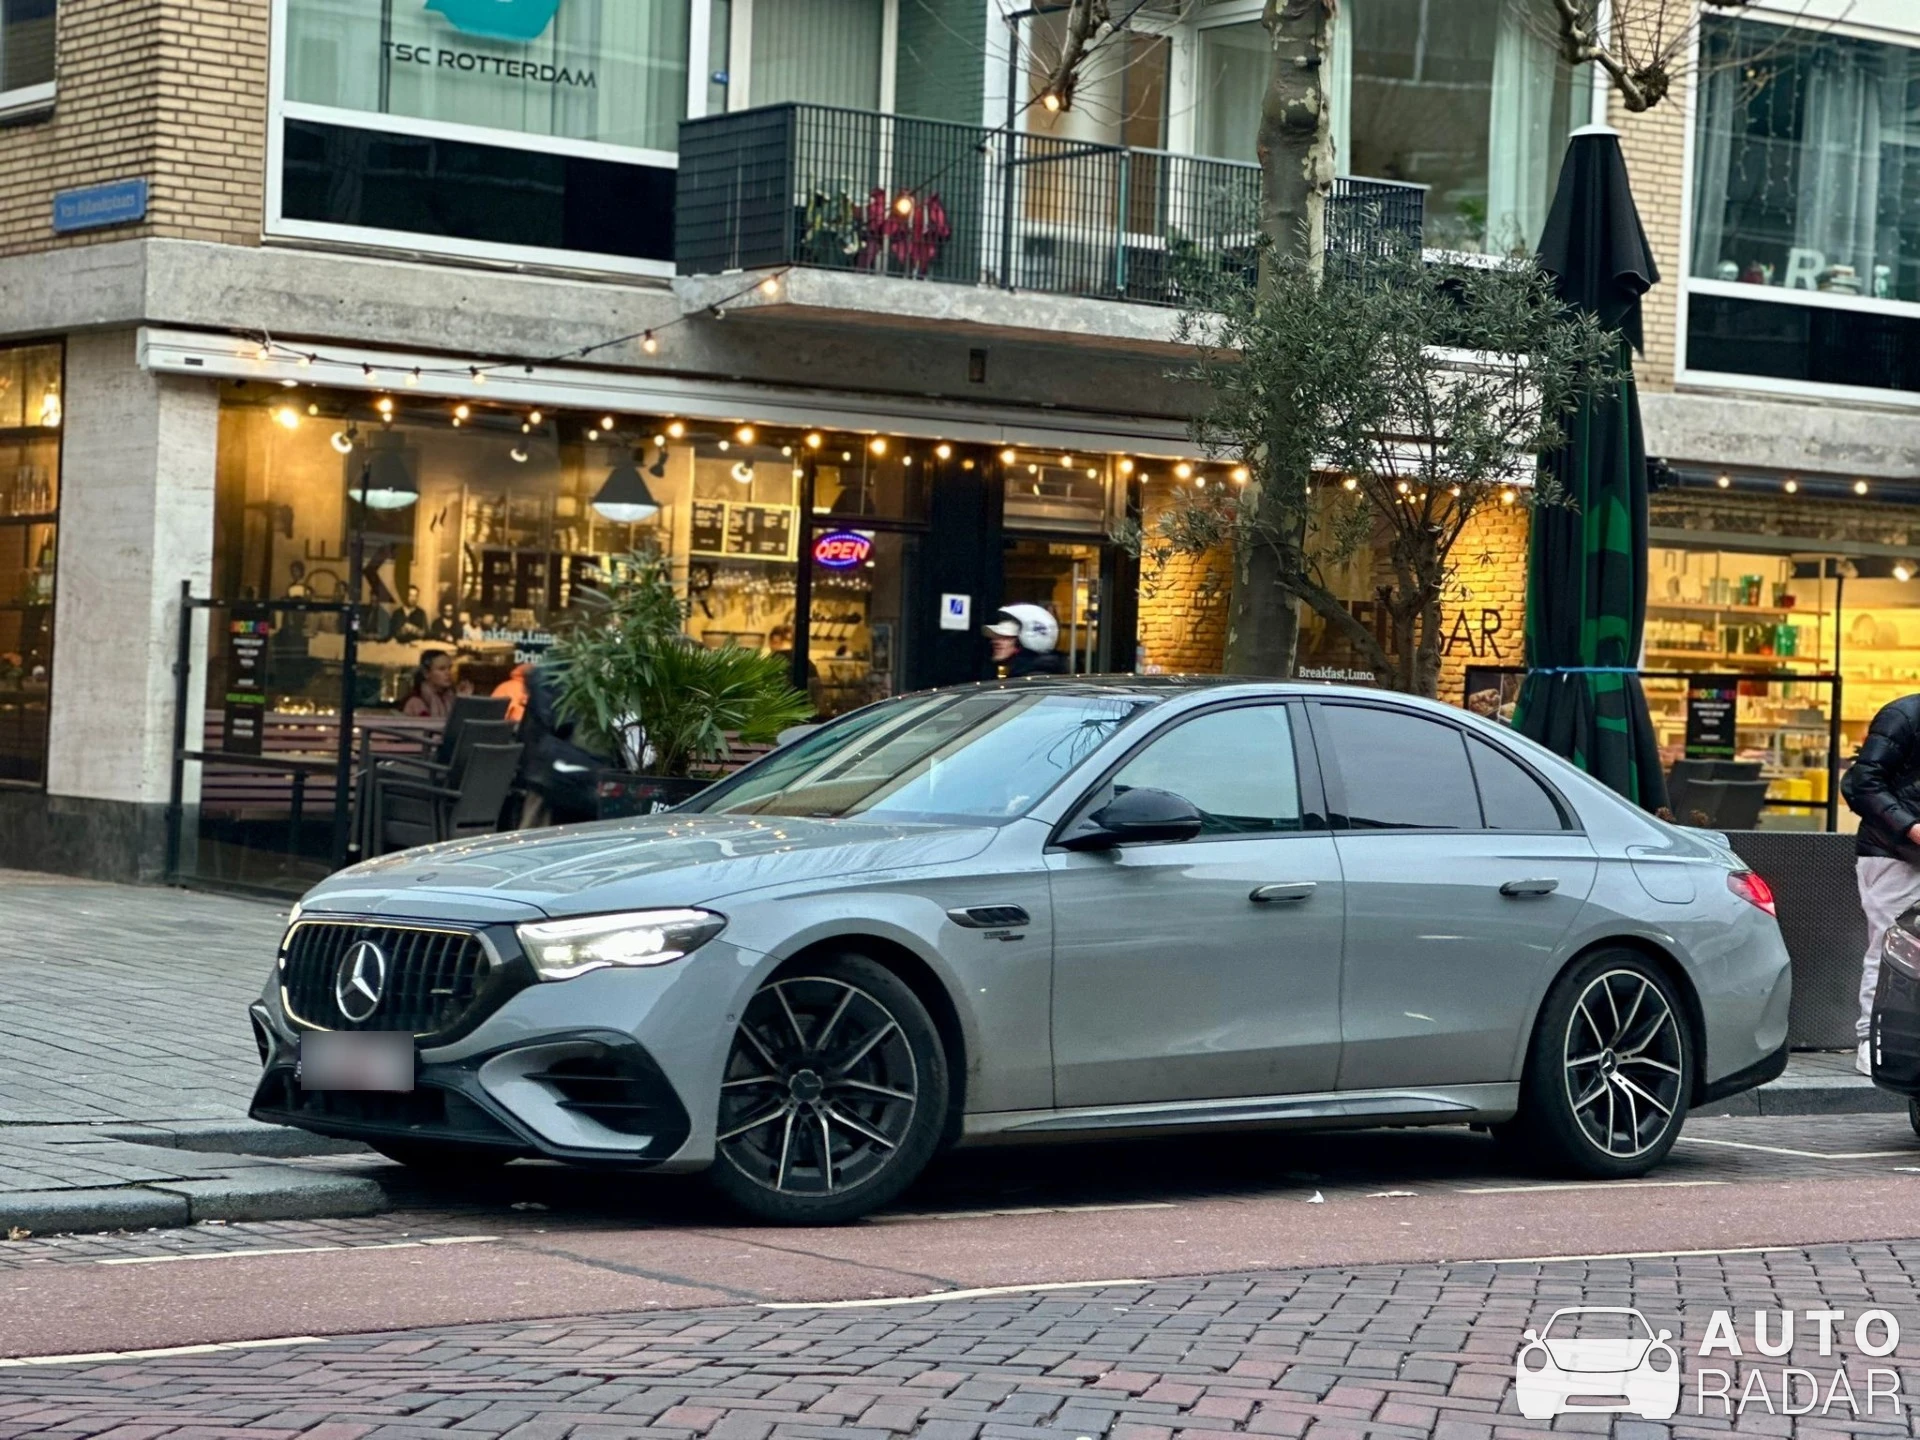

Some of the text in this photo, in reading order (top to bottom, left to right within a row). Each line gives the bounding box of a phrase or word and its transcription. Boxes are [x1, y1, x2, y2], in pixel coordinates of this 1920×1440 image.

[382, 41, 596, 89] TSC ROTTERDAM
[815, 541, 871, 559] OPEN
[1433, 606, 1503, 658] AR
